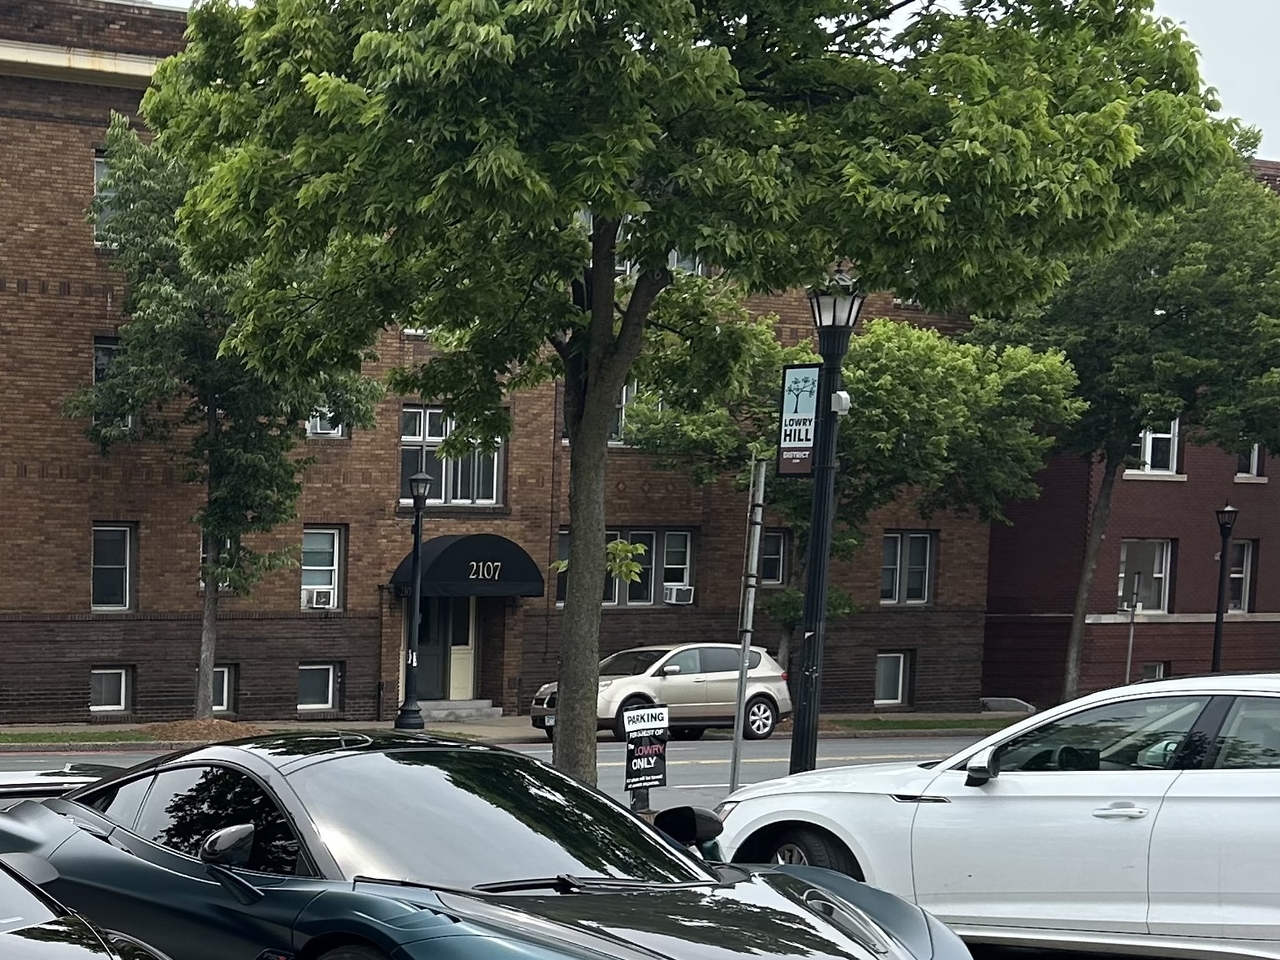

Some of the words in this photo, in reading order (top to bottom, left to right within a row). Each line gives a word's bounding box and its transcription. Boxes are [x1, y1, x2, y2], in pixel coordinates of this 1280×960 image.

[784, 418, 813, 427] LOWRY
[783, 428, 811, 442] HILL
[469, 561, 501, 580] 2107
[627, 712, 665, 725] PARKING
[635, 744, 664, 756] LOWRY
[631, 756, 657, 770] ONLY
